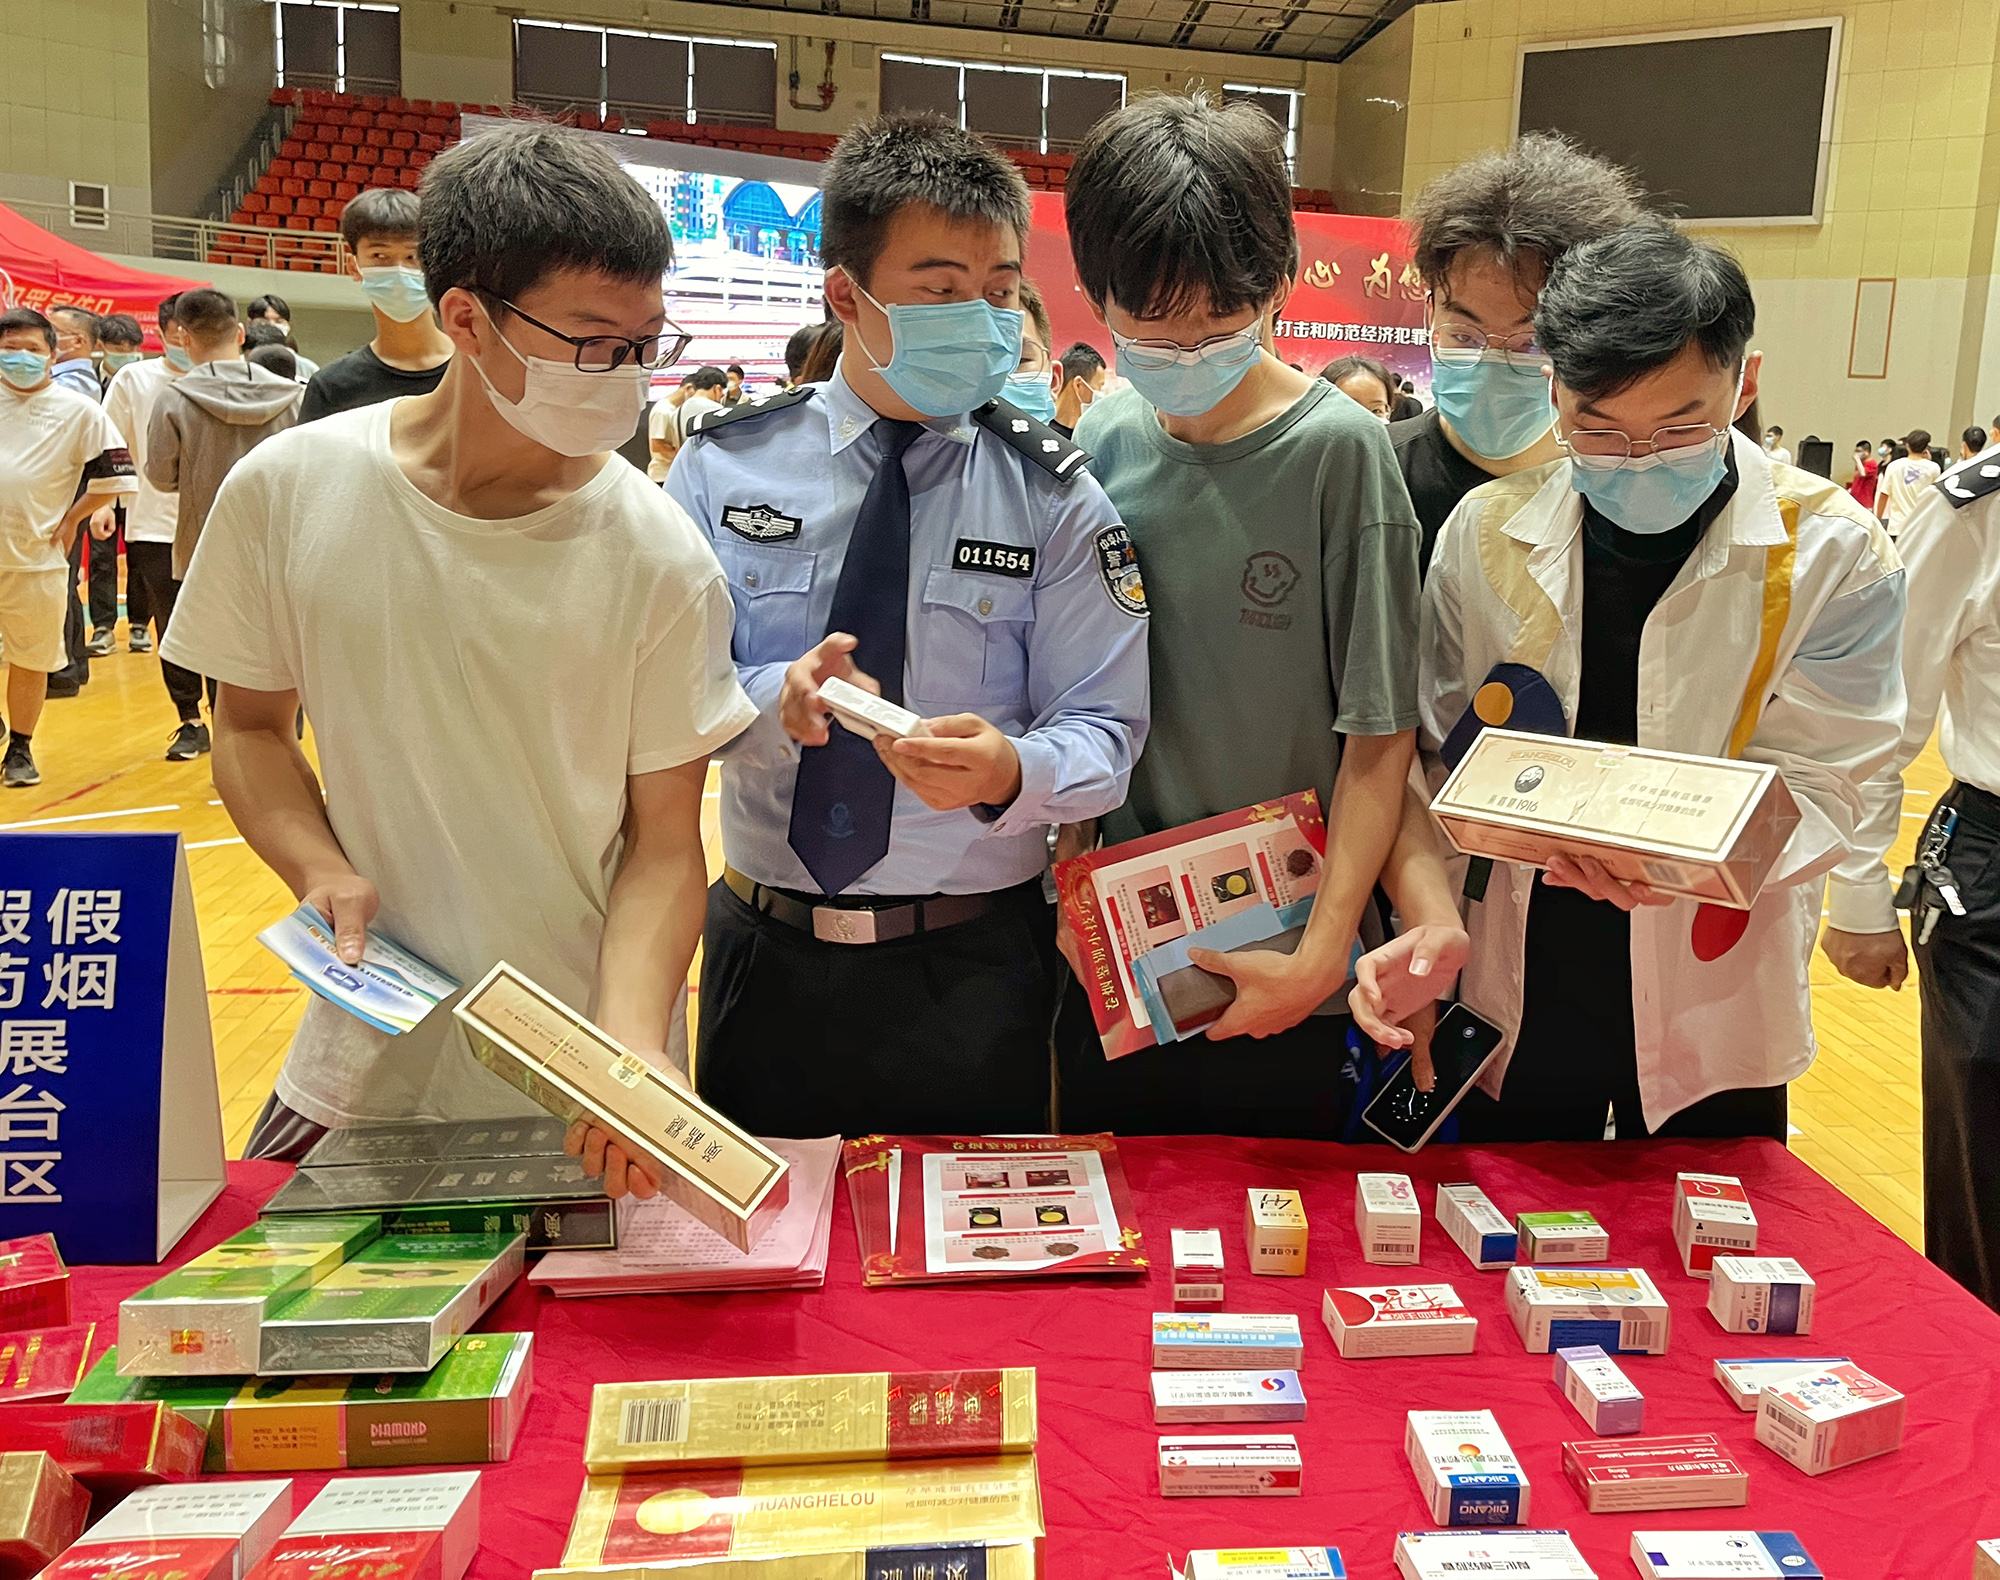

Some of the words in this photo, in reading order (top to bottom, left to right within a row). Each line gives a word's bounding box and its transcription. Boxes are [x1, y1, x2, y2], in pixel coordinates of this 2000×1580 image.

[1275, 319, 1432, 347] 打击和防范经济犯罪
[958, 545, 1031, 572] 011554
[40, 887, 122, 1011] 假烟
[370, 1421, 428, 1437] DIAMOND
